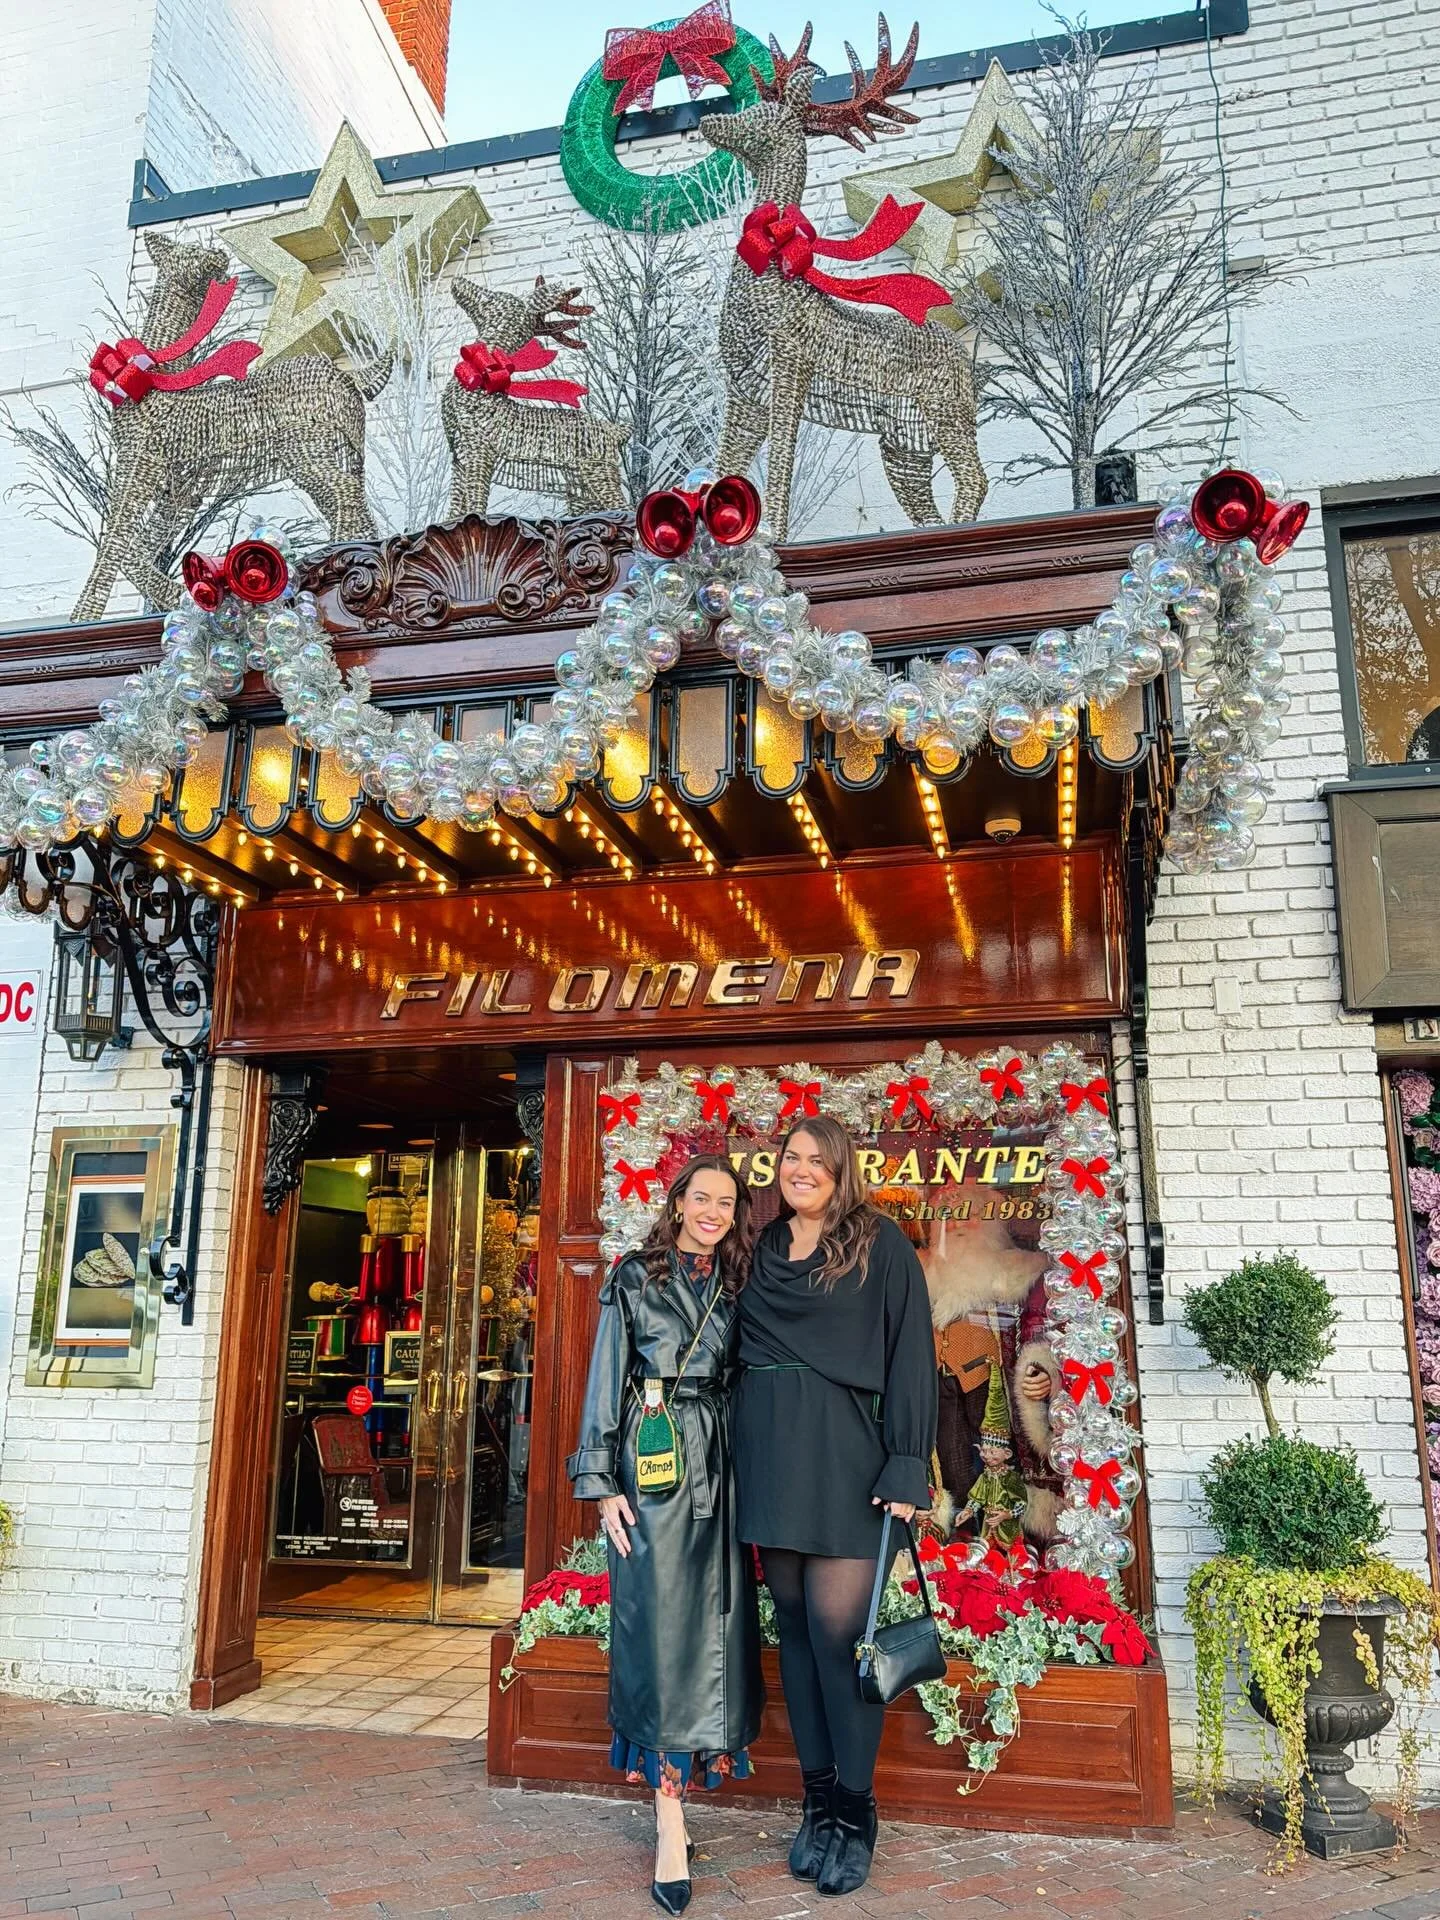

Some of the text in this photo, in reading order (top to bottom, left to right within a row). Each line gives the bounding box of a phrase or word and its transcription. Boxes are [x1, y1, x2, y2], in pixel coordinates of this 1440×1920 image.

[379, 948, 921, 1020] FILOMENA
[728, 1145, 1047, 1187] ISRANTE
[982, 1199, 1052, 1220] 1983
[395, 1349, 421, 1359] CAUT
